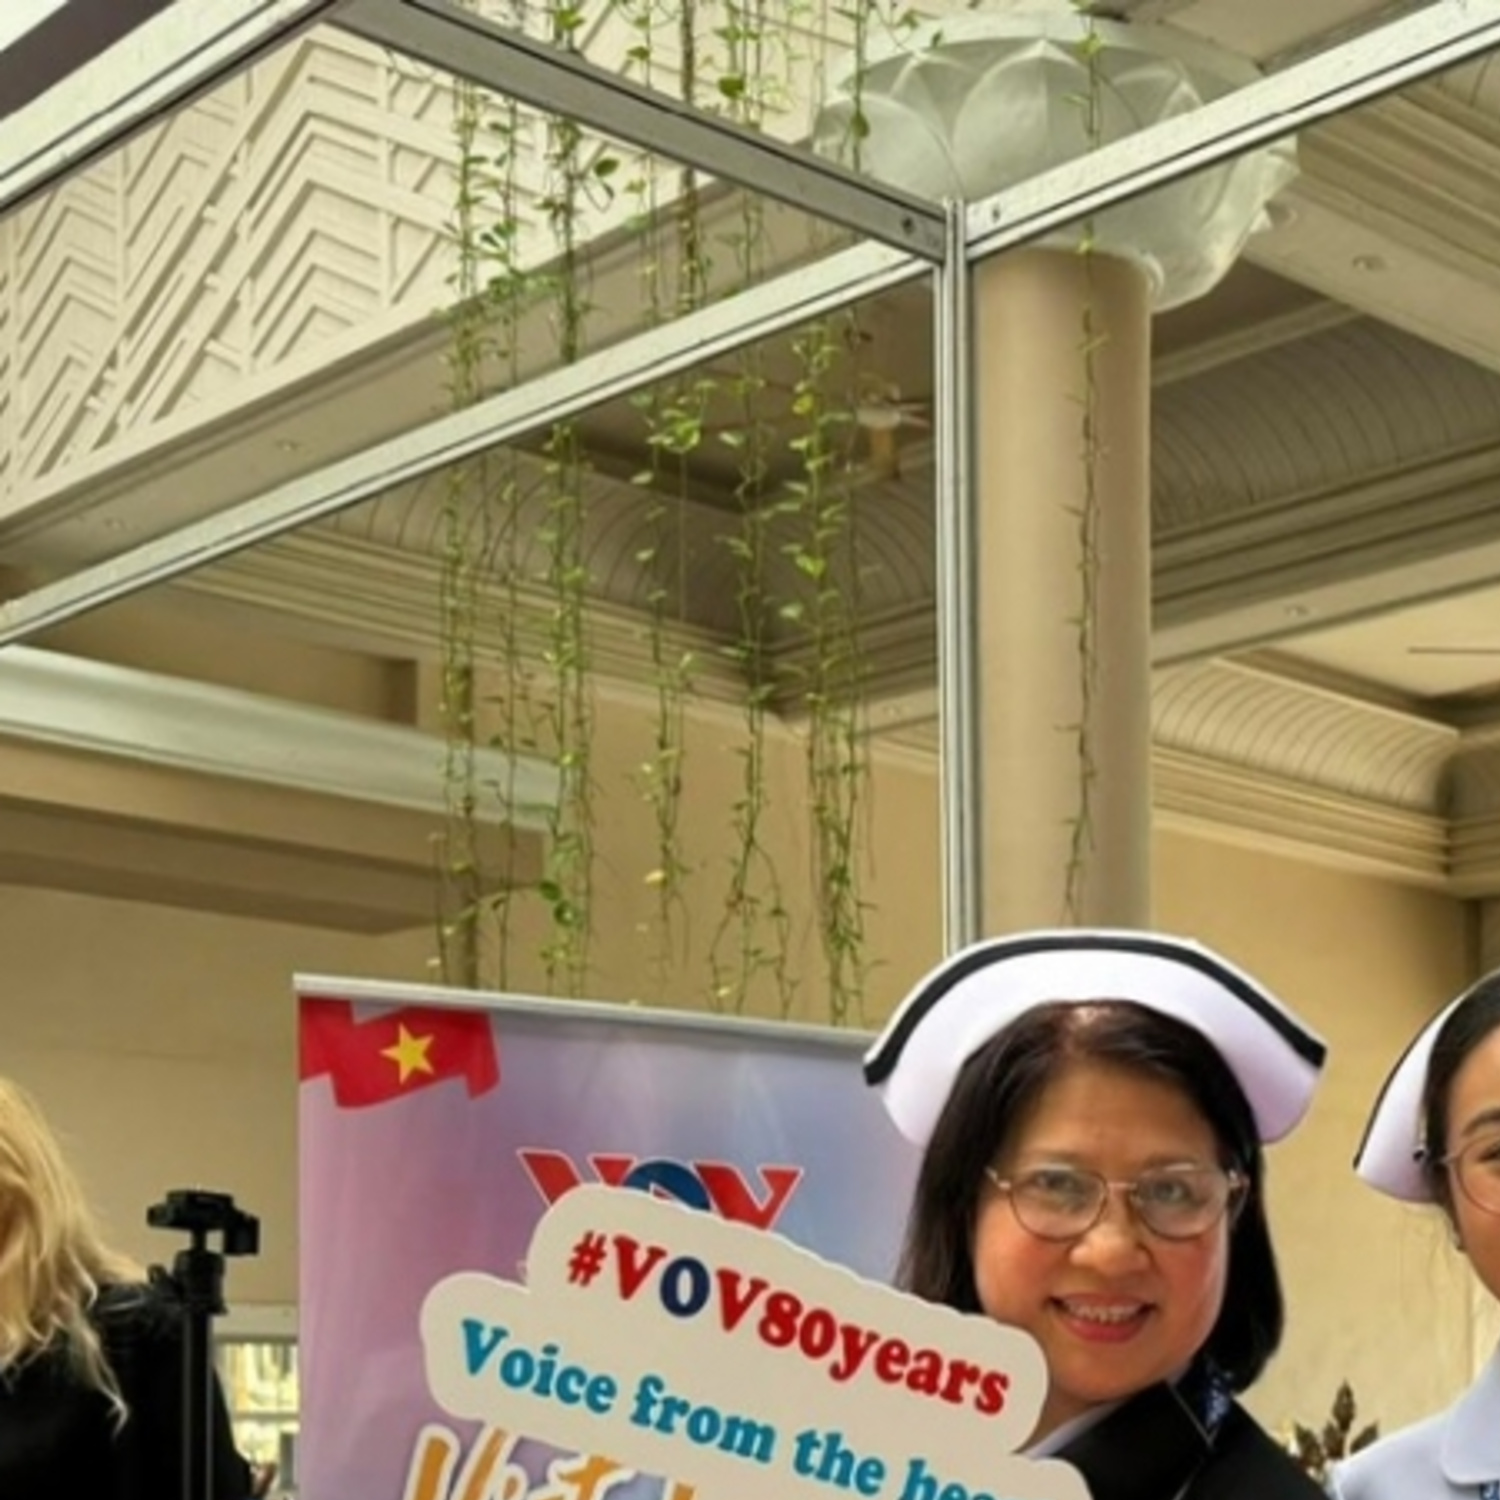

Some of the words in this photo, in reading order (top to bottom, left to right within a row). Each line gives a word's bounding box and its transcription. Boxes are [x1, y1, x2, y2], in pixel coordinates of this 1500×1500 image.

[461, 1318, 617, 1414] Voice
[629, 1375, 776, 1464] from
[793, 1429, 886, 1496] the
[567, 1231, 1011, 1417] #VOV80years
